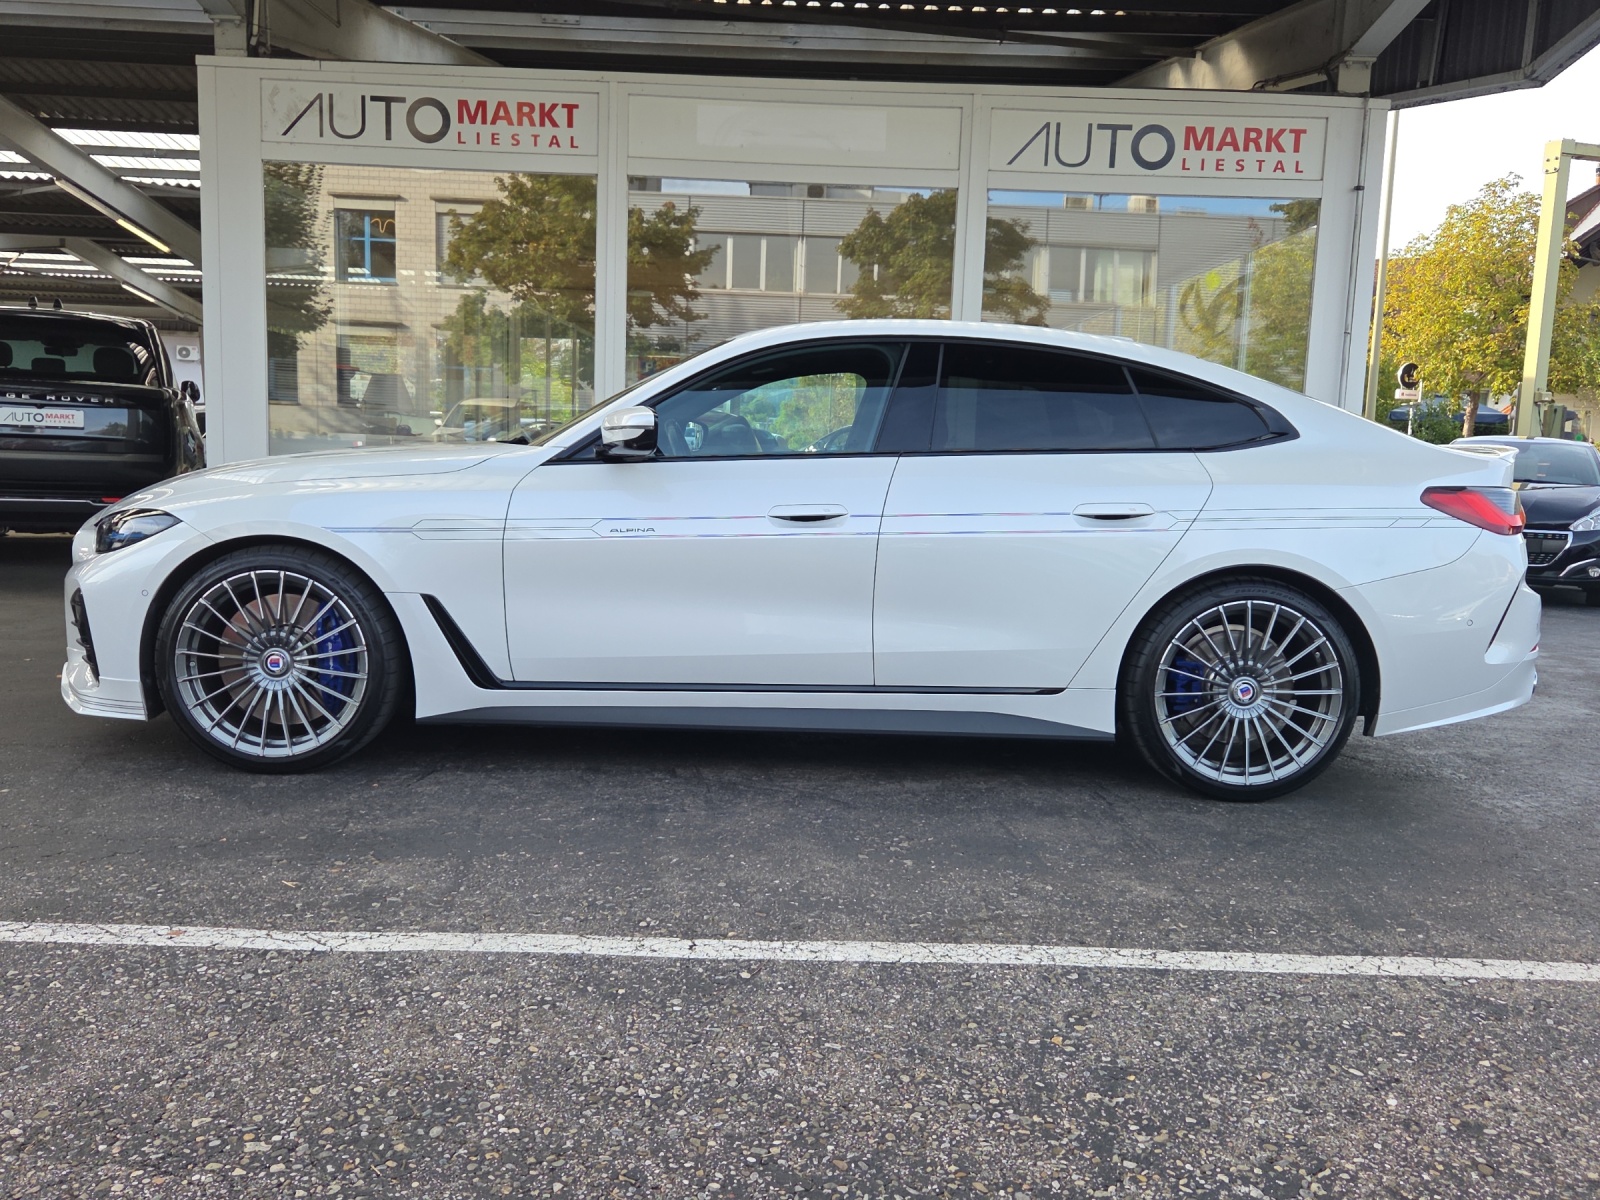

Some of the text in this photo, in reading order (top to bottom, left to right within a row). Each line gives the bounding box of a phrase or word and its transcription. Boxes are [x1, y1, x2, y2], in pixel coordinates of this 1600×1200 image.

[281, 93, 579, 143] AUTO MARKT
[457, 131, 579, 149] LIESTAL
[1006, 121, 1307, 171] AUTO MARKT
[1181, 157, 1304, 174] LIESTAL
[4, 411, 45, 422] AUTO
